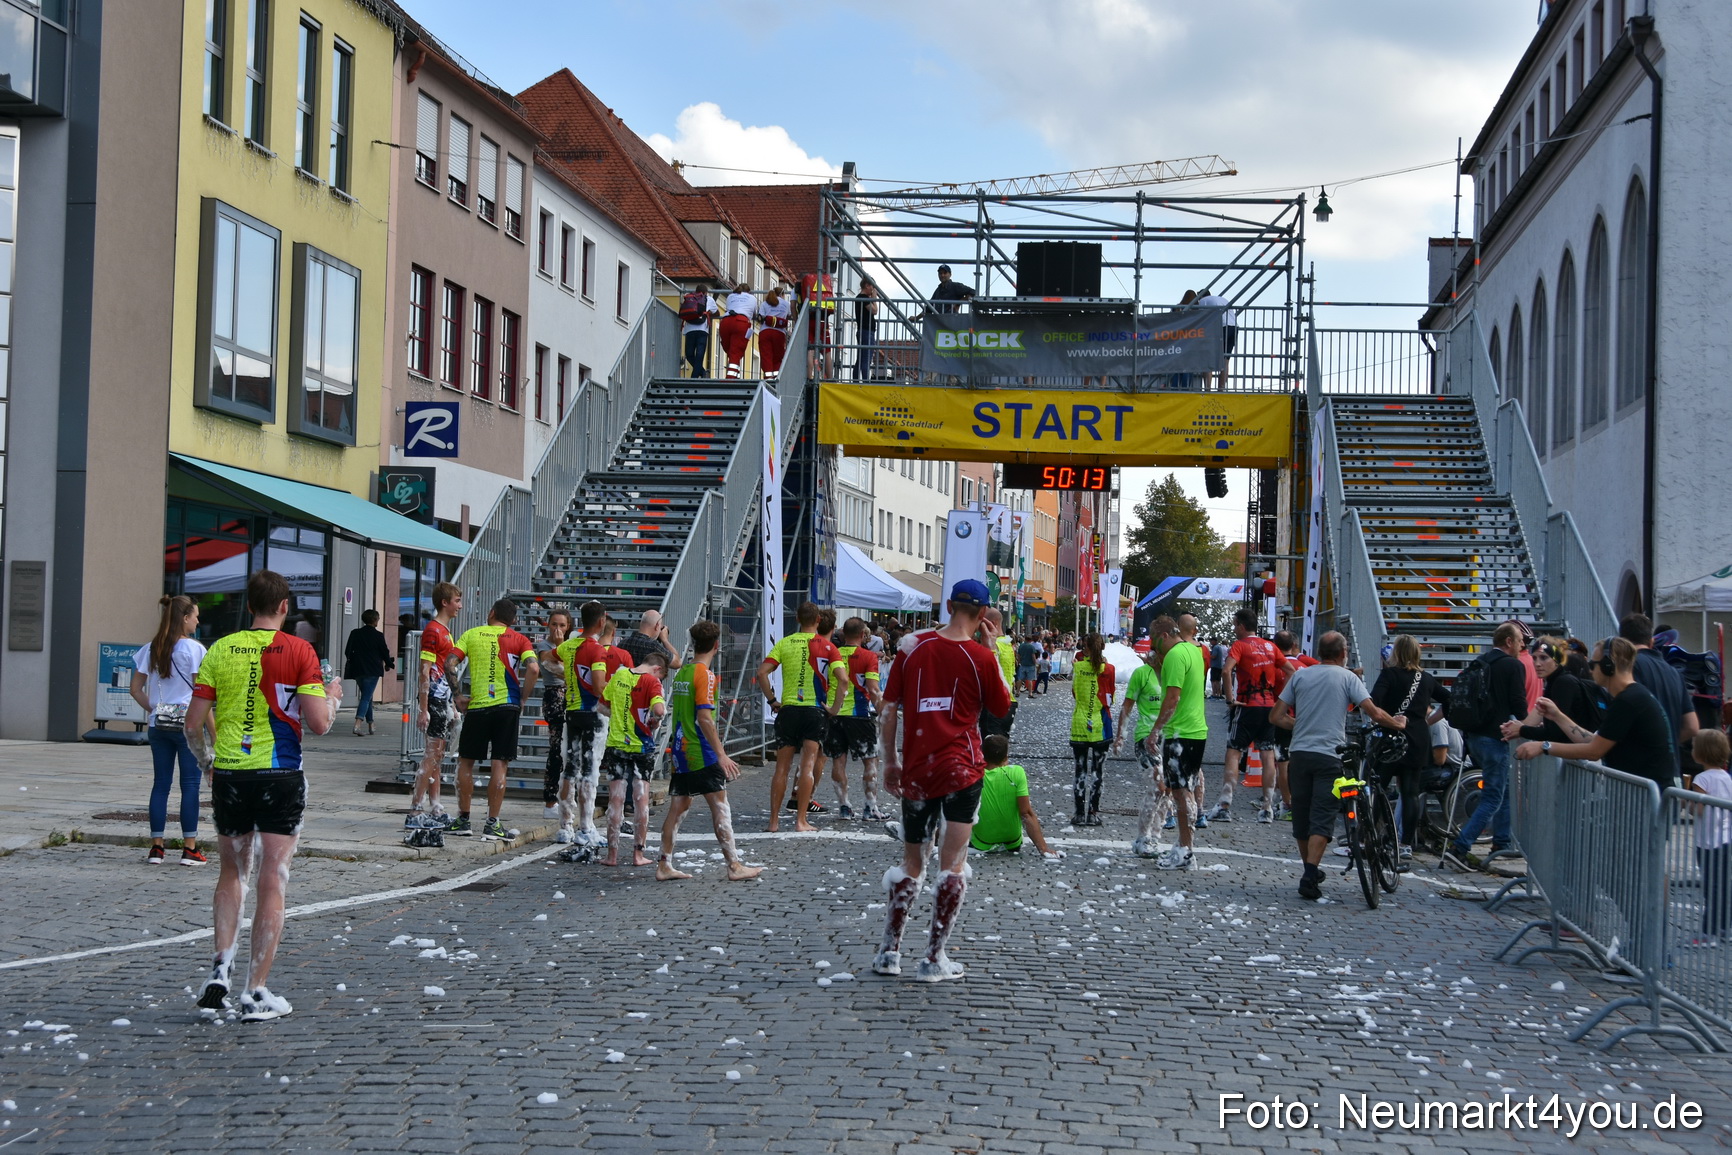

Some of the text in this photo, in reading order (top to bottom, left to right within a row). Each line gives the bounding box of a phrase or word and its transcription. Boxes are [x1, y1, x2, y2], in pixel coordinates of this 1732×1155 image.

[1043, 328, 1205, 343] OFFICE INDUSTRY LOUNGE
[994, 351, 1027, 359] concepts
[1067, 346, 1182, 358] www.bockonline.de
[844, 417, 944, 429] Neumarkter Stadtlauf
[971, 401, 1134, 441] START
[1161, 426, 1264, 437] Neumarkter Stadtlauf
[1043, 467, 1104, 490] 50:13
[229, 645, 257, 655] Team
[489, 641, 498, 683] Motorsport
[798, 646, 808, 687] Motorsport
[821, 659, 829, 674] 7
[580, 666, 590, 680] 7
[243, 661, 259, 732] Motorsport
[283, 686, 298, 712] 7
[1087, 681, 1097, 719] Motorsport
